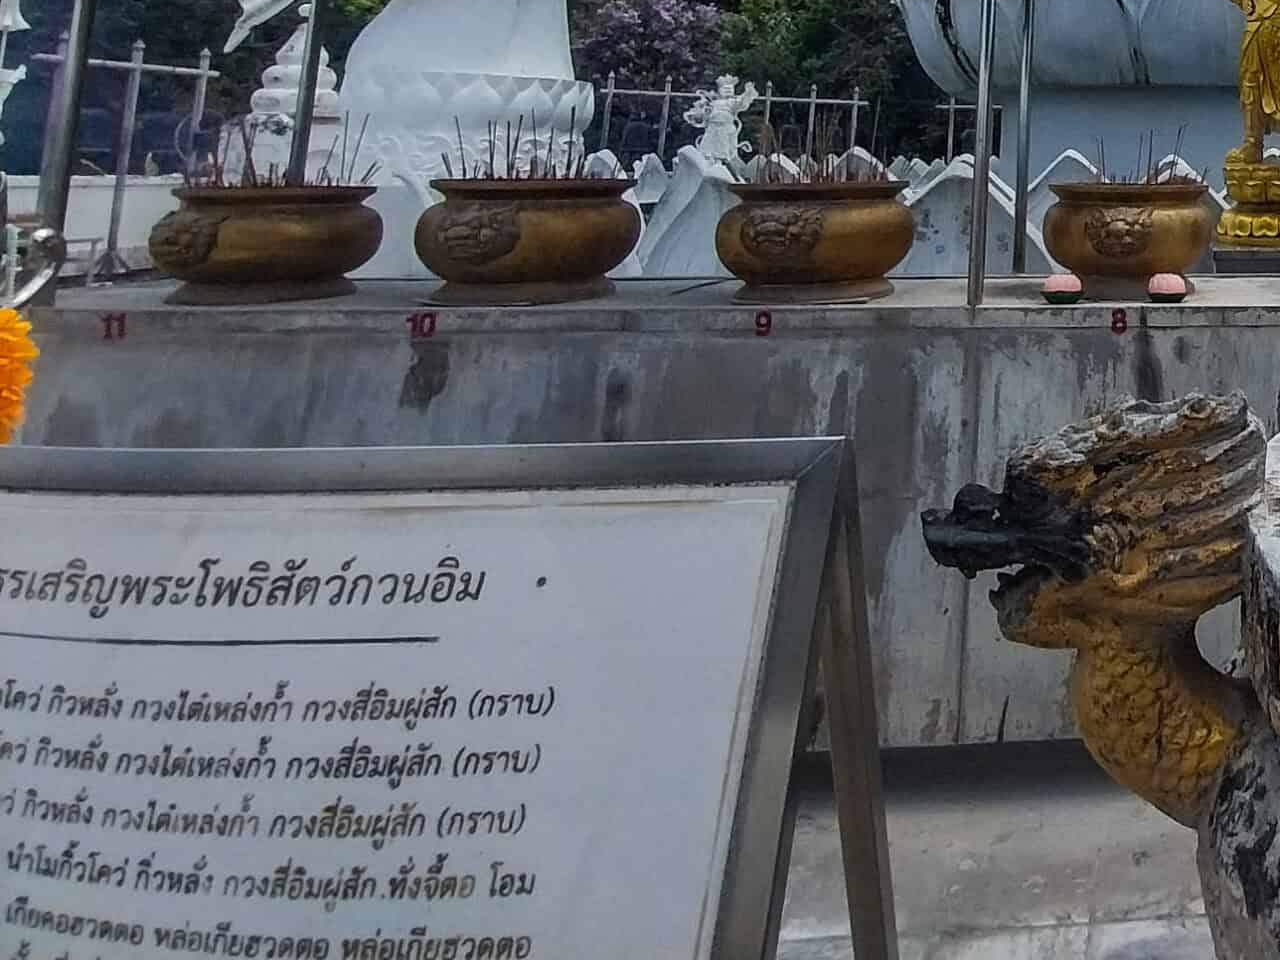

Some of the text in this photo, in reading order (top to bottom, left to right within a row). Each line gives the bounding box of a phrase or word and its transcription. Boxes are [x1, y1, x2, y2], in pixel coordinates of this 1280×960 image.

[405, 311, 437, 338] 10
[755, 310, 772, 336] 9
[468, 686, 555, 720] (กราบ)
[453, 744, 541, 778] (กราบ)
[436, 803, 526, 839] (กราบ)
[488, 860, 536, 899] โอม
